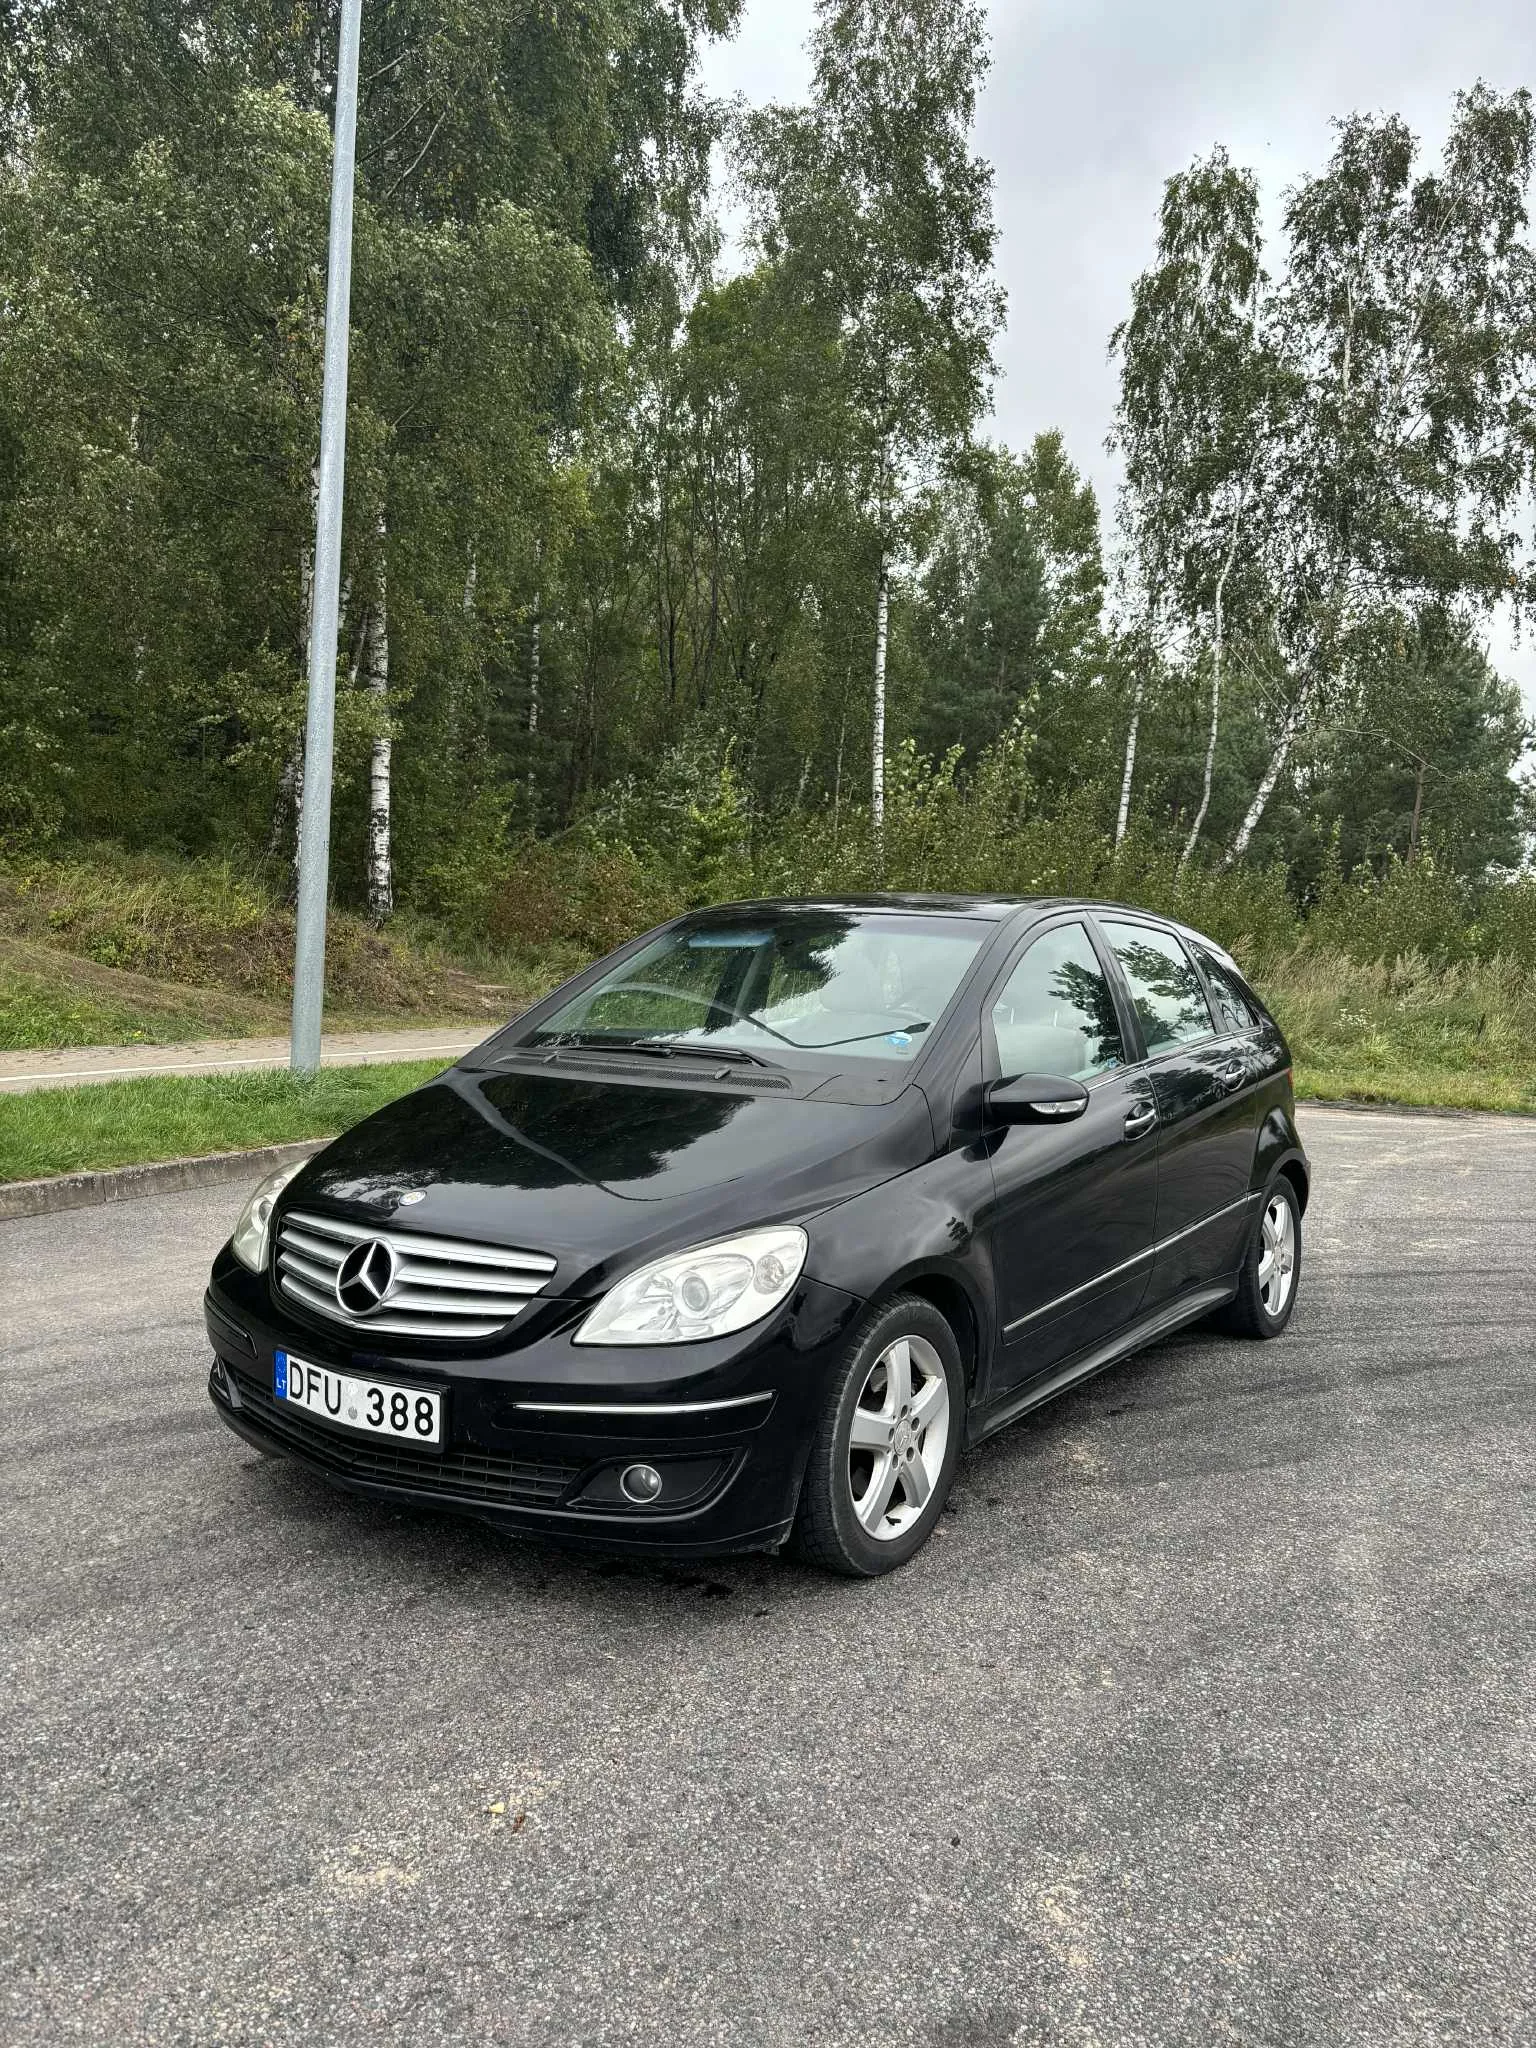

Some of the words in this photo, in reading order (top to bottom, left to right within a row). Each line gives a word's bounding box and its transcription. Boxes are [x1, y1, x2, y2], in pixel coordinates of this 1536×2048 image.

[276, 1378, 287, 1389] LT
[289, 1360, 342, 1415] DFU
[366, 1387, 434, 1436] 388
